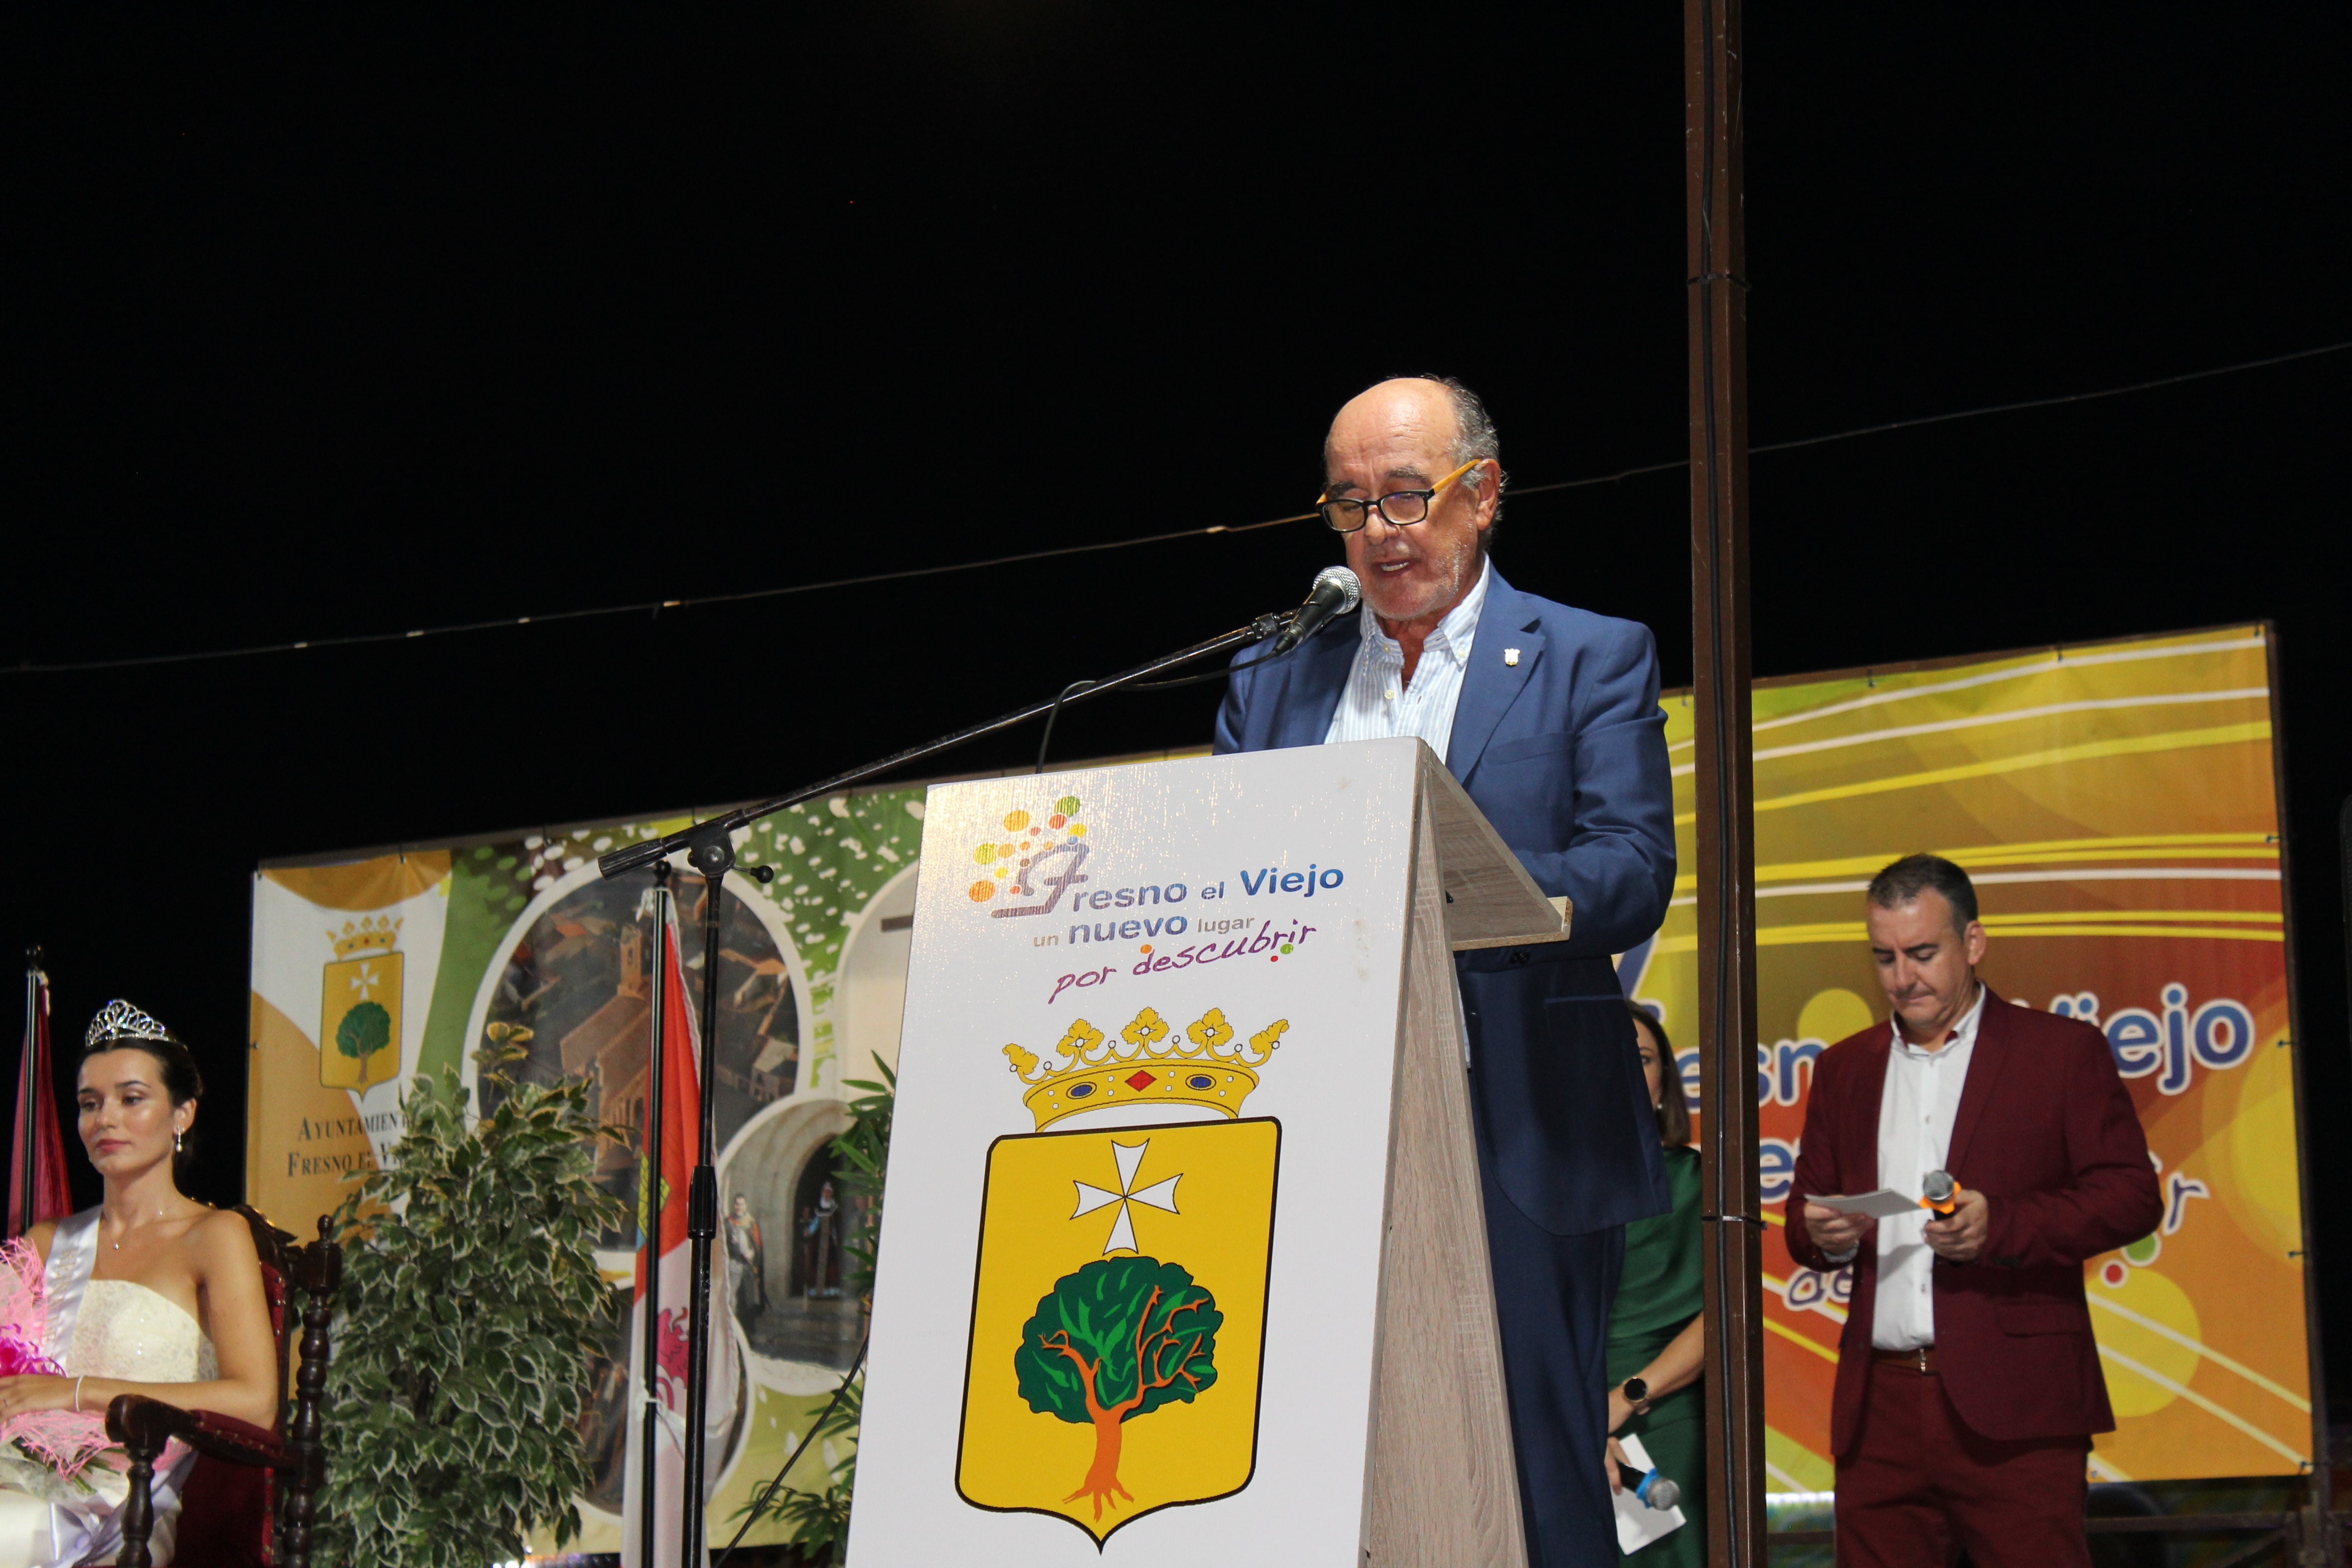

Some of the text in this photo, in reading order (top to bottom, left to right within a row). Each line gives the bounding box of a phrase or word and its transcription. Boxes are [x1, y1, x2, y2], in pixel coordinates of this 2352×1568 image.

[1201, 881, 1225, 900] el
[1240, 864, 1344, 897] Viejo
[1033, 916, 1254, 947] un nuevo lugar
[1048, 919, 1317, 1004] por descubrir
[287, 1150, 352, 1177] FRESNO
